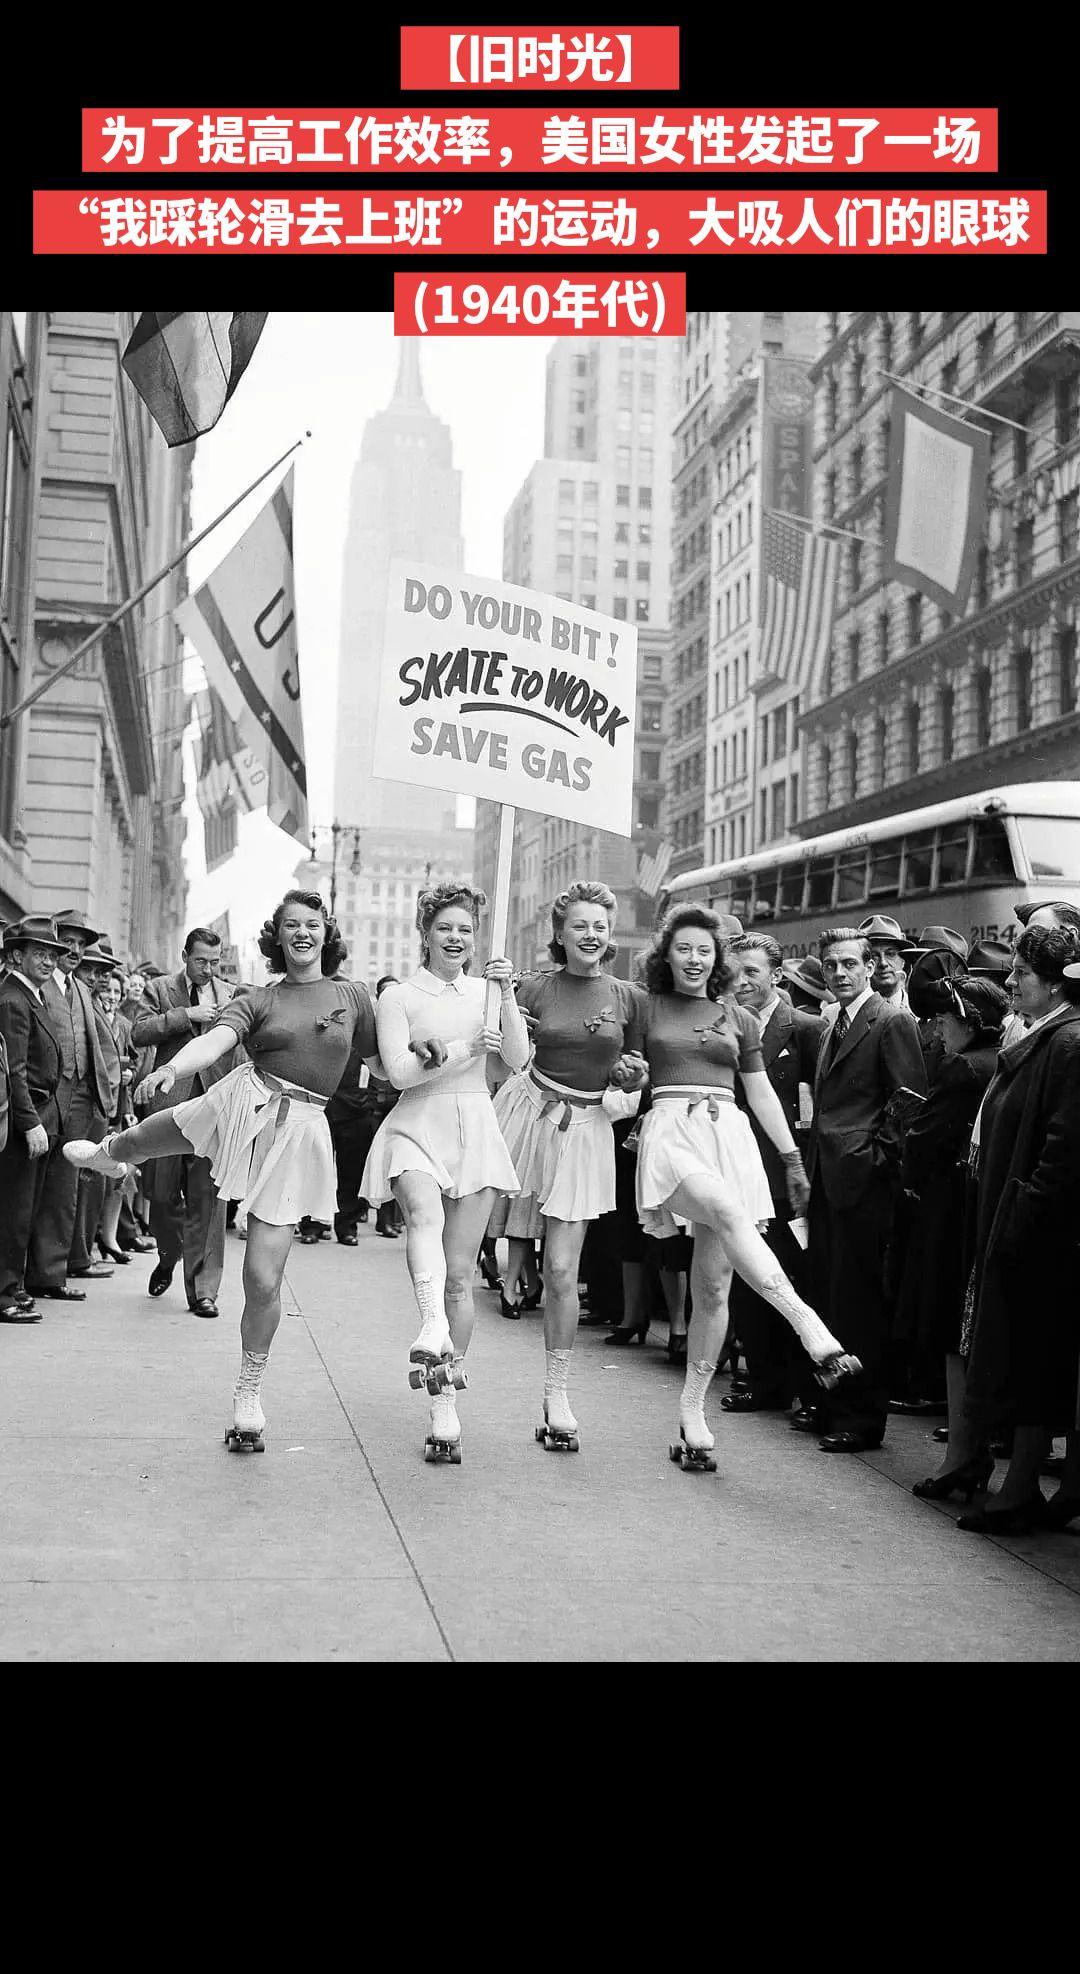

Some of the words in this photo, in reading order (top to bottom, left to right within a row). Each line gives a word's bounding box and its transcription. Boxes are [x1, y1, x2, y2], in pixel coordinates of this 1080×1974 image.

[403, 577, 453, 620] DO
[460, 590, 542, 643] YOUR
[399, 647, 508, 707] SKATE
[511, 665, 543, 701] TO
[545, 667, 630, 748] WORK
[410, 717, 509, 771] SAVE
[521, 743, 593, 792] GAS
[970, 924, 1017, 944] 2154
